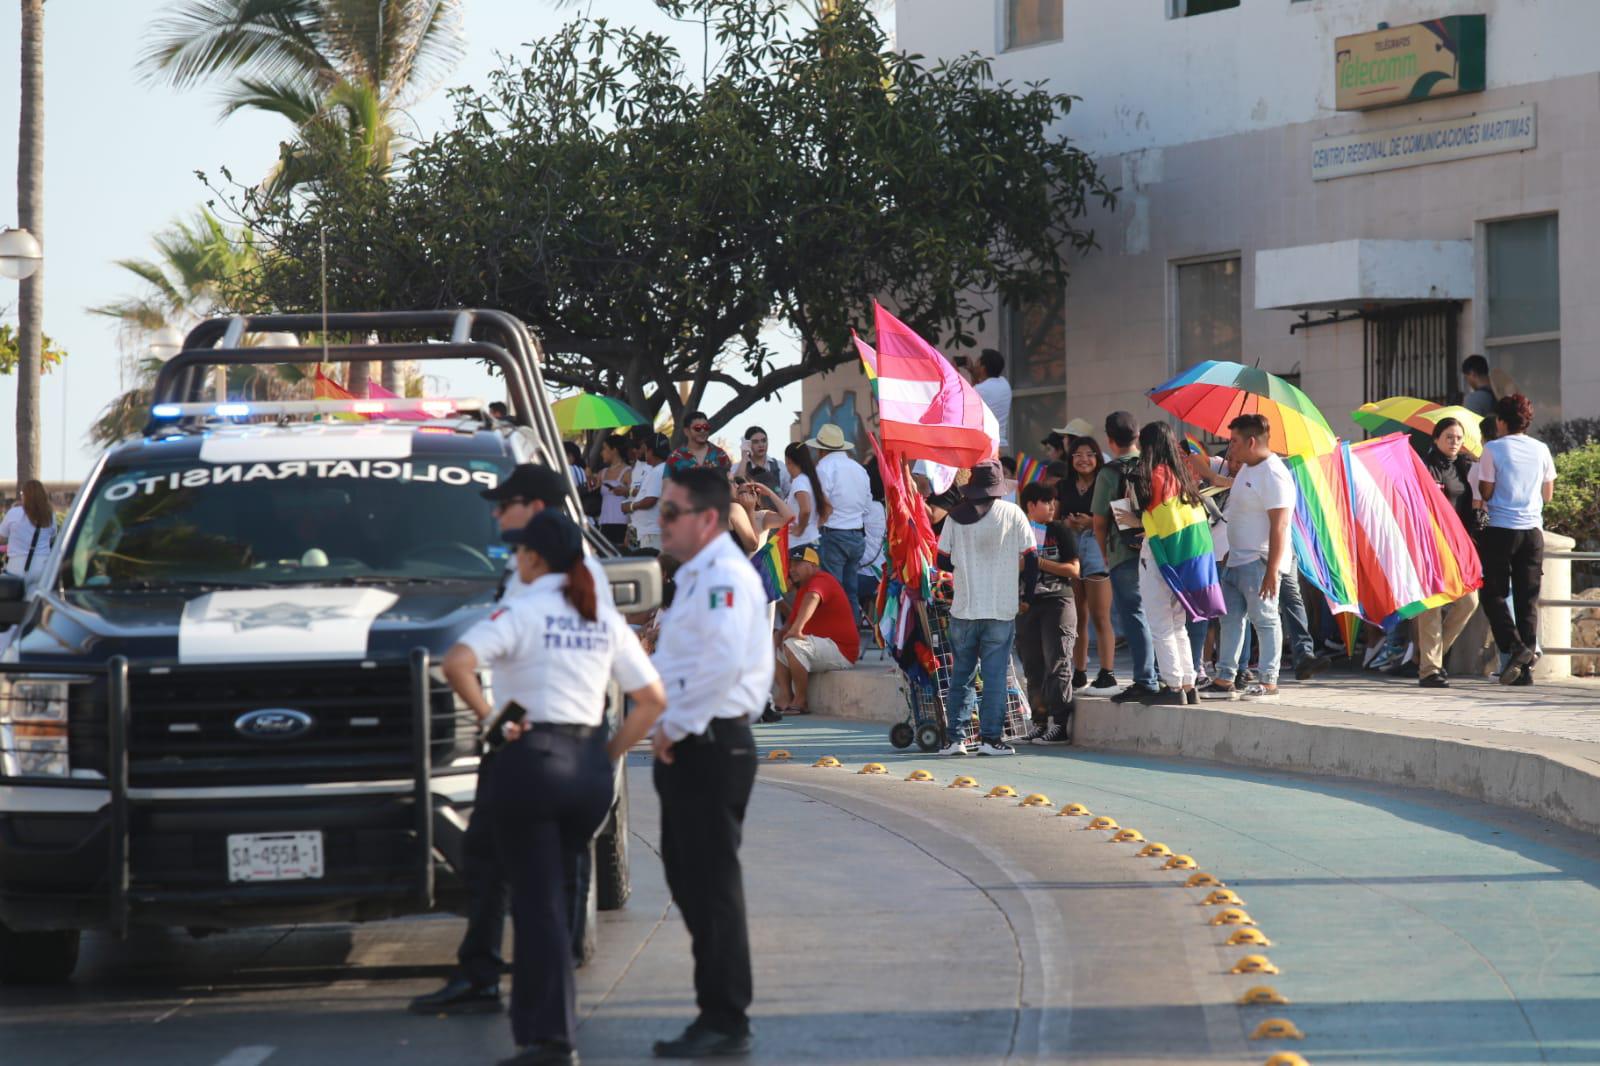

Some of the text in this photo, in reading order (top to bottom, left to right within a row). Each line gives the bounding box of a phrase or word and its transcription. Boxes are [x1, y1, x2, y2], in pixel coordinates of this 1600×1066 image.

[1313, 146, 1345, 168] CENTRO
[1347, 137, 1387, 163] REGIONAL
[1389, 137, 1401, 156] DE
[1402, 124, 1480, 154] COMUNICACIONES
